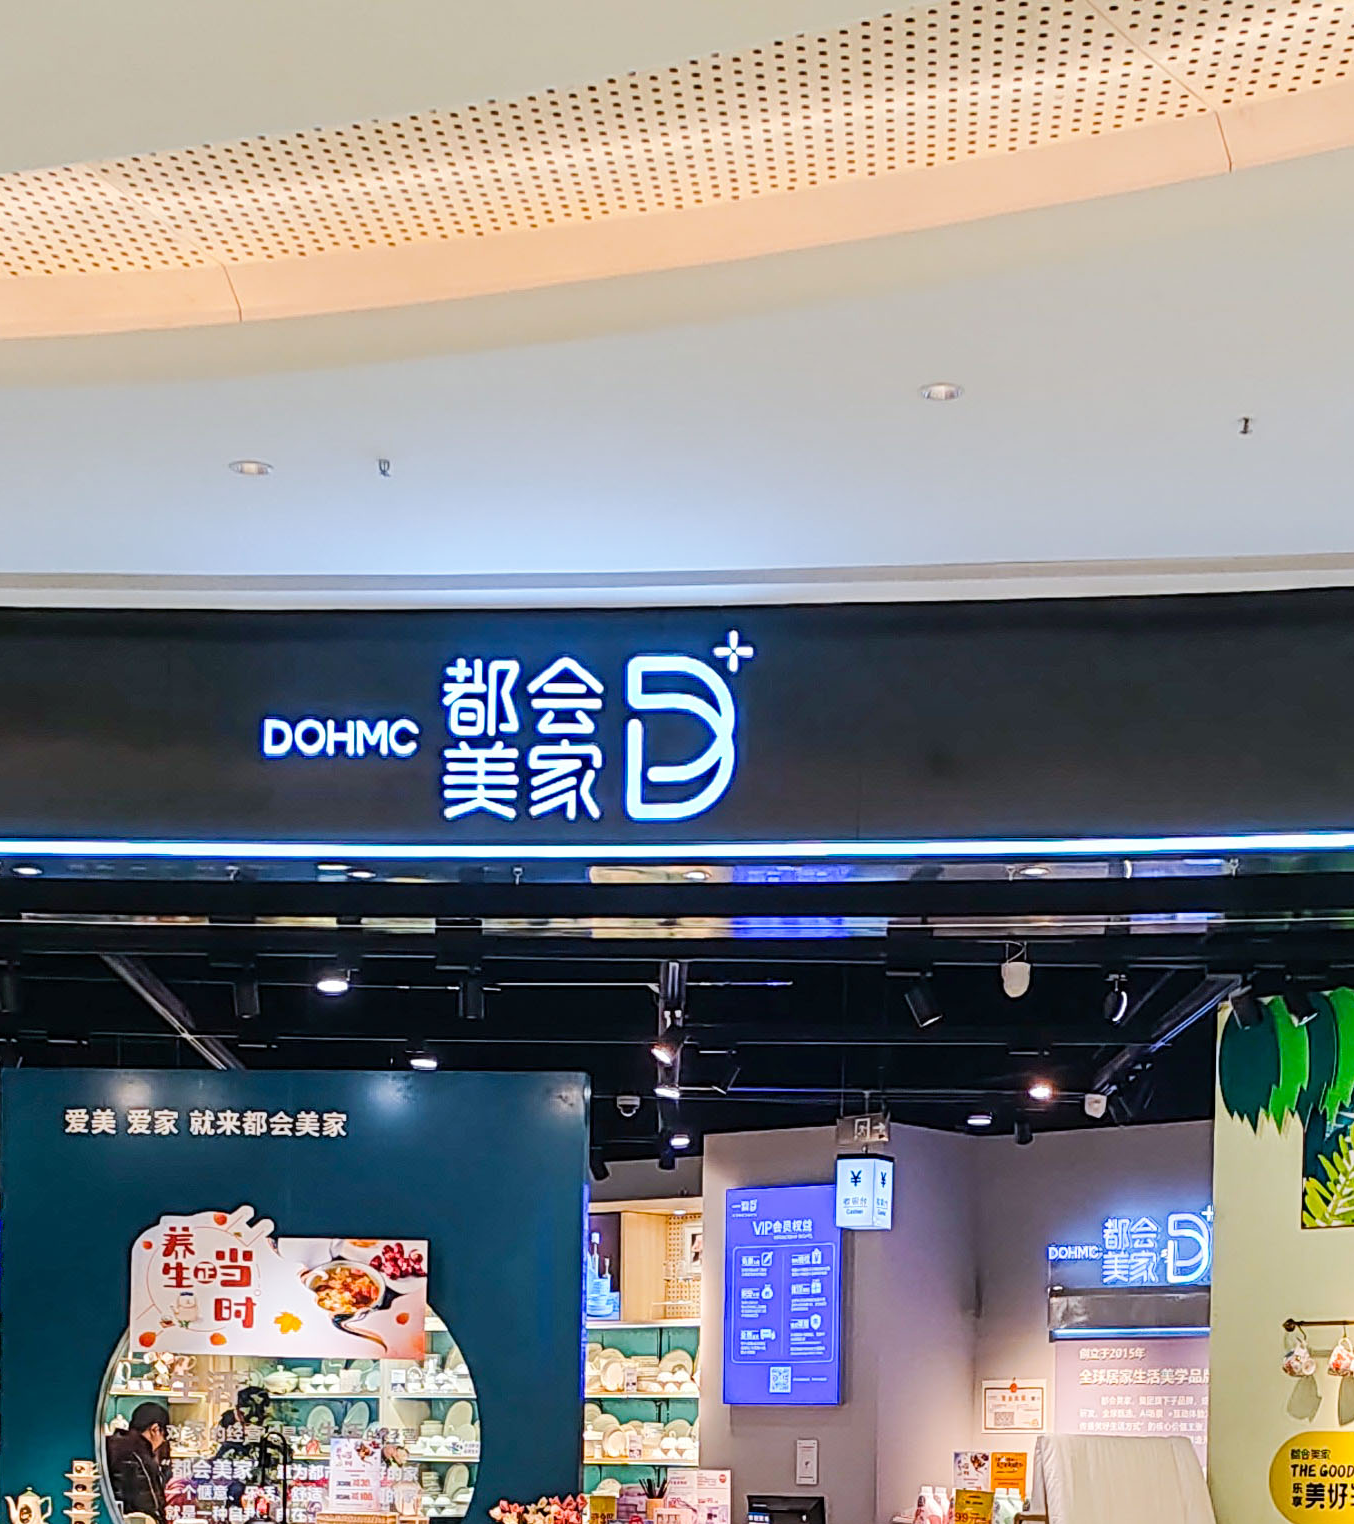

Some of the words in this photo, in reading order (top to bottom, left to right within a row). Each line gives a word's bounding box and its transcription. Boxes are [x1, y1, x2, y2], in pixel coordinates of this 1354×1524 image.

[443, 656, 605, 738] 都会
[262, 718, 420, 757] DOHMC
[443, 739, 603, 821] 美家
[64, 1108, 117, 1136] 爱美
[127, 1108, 179, 1137] 爱家
[189, 1109, 347, 1138] 就来都会美家
[1102, 1216, 1160, 1248] 都会
[161, 1226, 196, 1288] 养生
[1048, 1245, 1102, 1260] DOHMC
[1102, 1250, 1160, 1284] 美家
[213, 1247, 258, 1329] 当时
[1290, 1464, 1317, 1478] THE
[1319, 1464, 1354, 1478] GOOD
